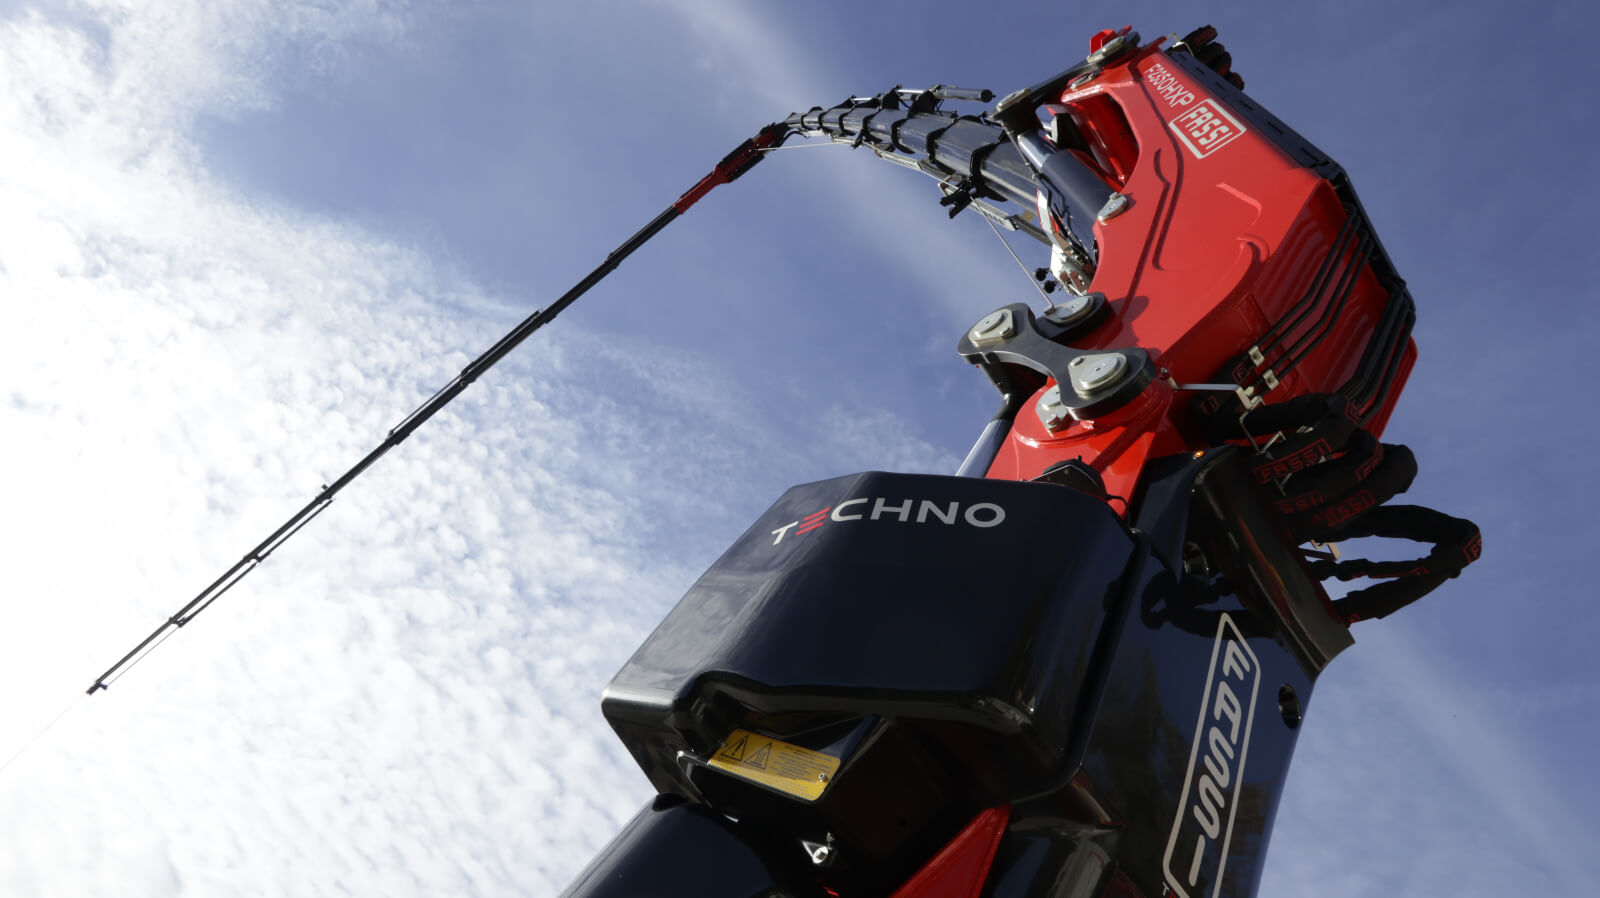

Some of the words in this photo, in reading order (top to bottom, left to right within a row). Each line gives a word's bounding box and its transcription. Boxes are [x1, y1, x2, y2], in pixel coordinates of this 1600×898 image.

[1180, 106, 1233, 150] FASSI
[771, 498, 1006, 546] TECHNO
[1188, 639, 1251, 887] FASSI
